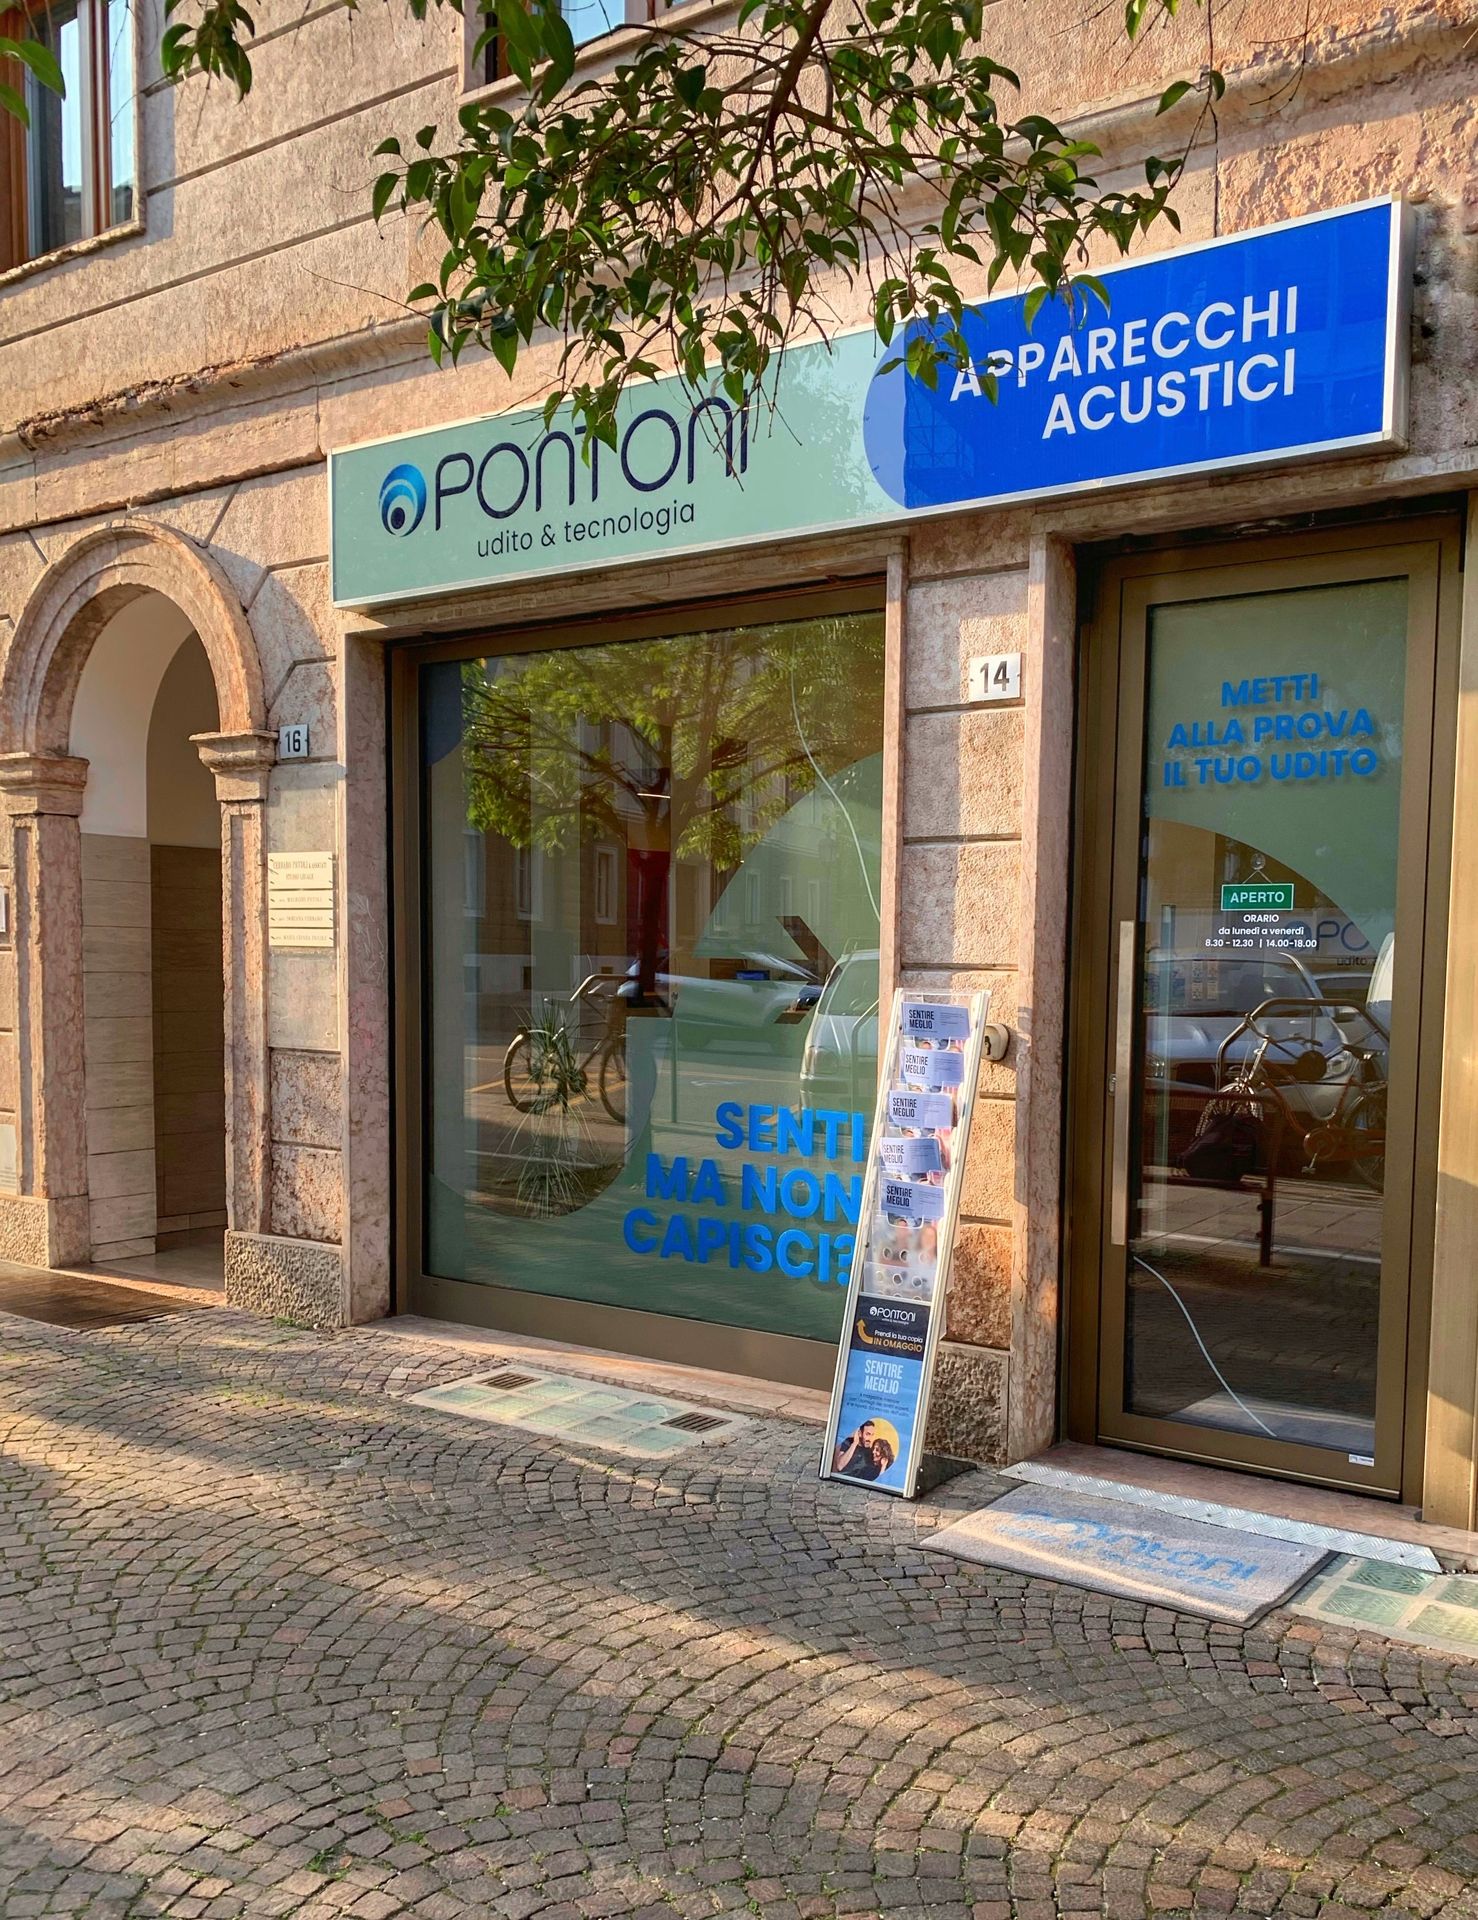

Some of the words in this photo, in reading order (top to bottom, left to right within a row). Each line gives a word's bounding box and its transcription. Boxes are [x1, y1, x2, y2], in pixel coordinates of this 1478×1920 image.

[949, 285, 1298, 402] APPARECCHI
[1041, 348, 1296, 440] ACUSTICI
[434, 388, 749, 532] PONTONI
[477, 530, 533, 558] udito
[541, 524, 557, 546] &
[564, 499, 696, 544] tecnologia
[980, 660, 1010, 694] 14
[1221, 672, 1319, 707] METTI
[1167, 718, 1245, 749] ALLA
[1253, 708, 1375, 743] PROVA
[284, 729, 301, 753] 16
[1163, 761, 1188, 787] IL
[1195, 755, 1263, 785] TUO
[1269, 748, 1378, 780] UDITO
[1230, 891, 1285, 903] APERTO
[1243, 914, 1280, 923] ORARIO
[1218, 927, 1231, 935] da
[1205, 938, 1224, 947] 8.30
[1232, 938, 1254, 947] 12.30
[1266, 938, 1318, 948] 14.00-18.00
[908, 1009, 935, 1020] SENTIRE
[909, 1019, 933, 1029] MEGLIO
[905, 1054, 928, 1066] SENTIRE
[905, 1064, 926, 1075] MEGLIO
[892, 1097, 917, 1108] SENTIRE
[892, 1107, 915, 1118] MEGLIO
[715, 1101, 864, 1163] SENTI
[882, 1143, 905, 1155] SENTIRE
[883, 1153, 904, 1164] MEGLIO
[645, 1153, 726, 1207] MA
[741, 1163, 863, 1224] NON
[886, 1185, 913, 1198] SENTIRE
[886, 1195, 910, 1207] MEGLIO
[623, 1206, 856, 1287] CAPISCI?
[874, 1329, 891, 1338] Prendi
[873, 1337, 882, 1346] IN
[883, 1339, 923, 1353] OMAGGIO
[864, 1359, 904, 1380] SENTIRE
[864, 1376, 900, 1395] MEGLIO
